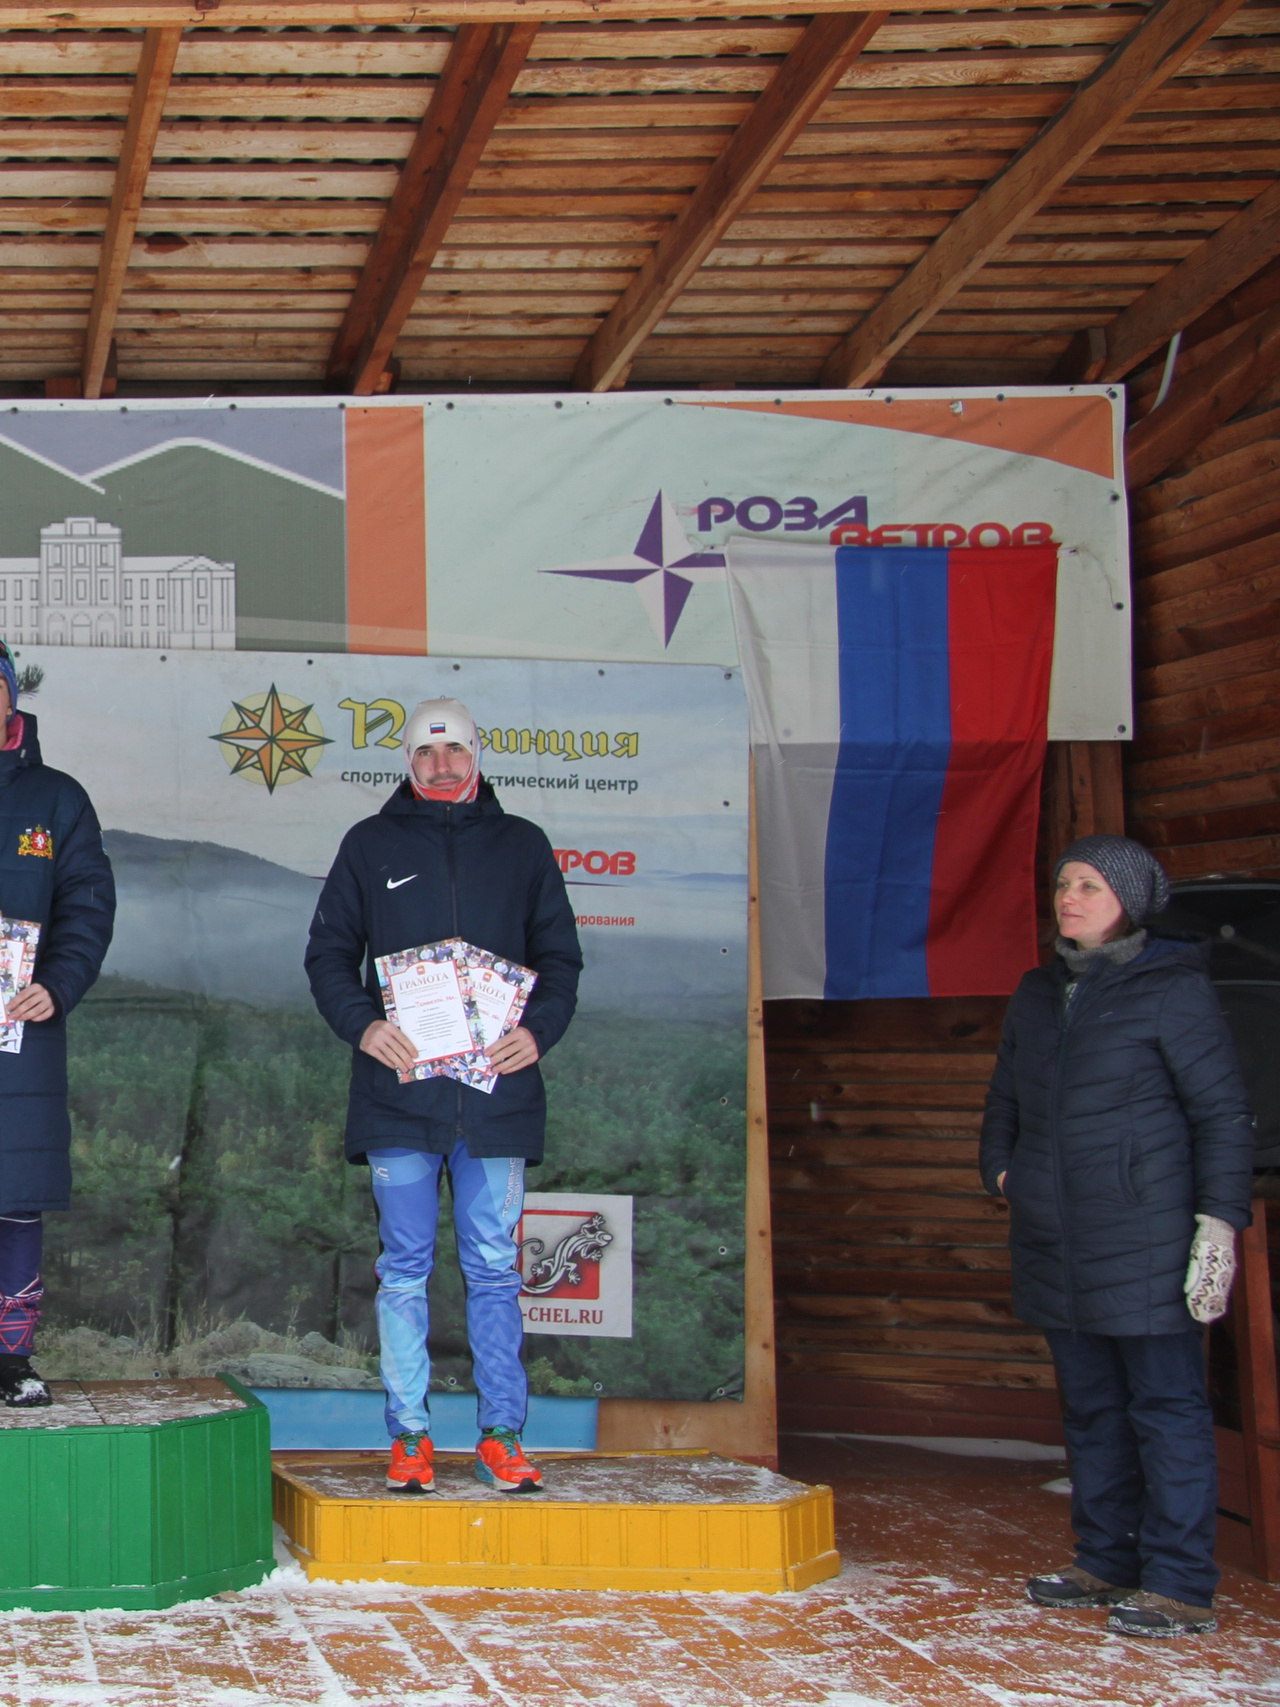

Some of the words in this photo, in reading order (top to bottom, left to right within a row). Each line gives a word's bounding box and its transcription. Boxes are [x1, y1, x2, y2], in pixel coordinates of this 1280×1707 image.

[697, 495, 868, 531] РОЗА
[830, 522, 1053, 548] ВЕТРОВ
[337, 697, 639, 761] Пинция
[585, 779, 638, 794] центр
[399, 973, 450, 990] ГРАМОТА
[472, 980, 507, 1000] АМОТА
[522, 1307, 603, 1325] -CHEL.RU
